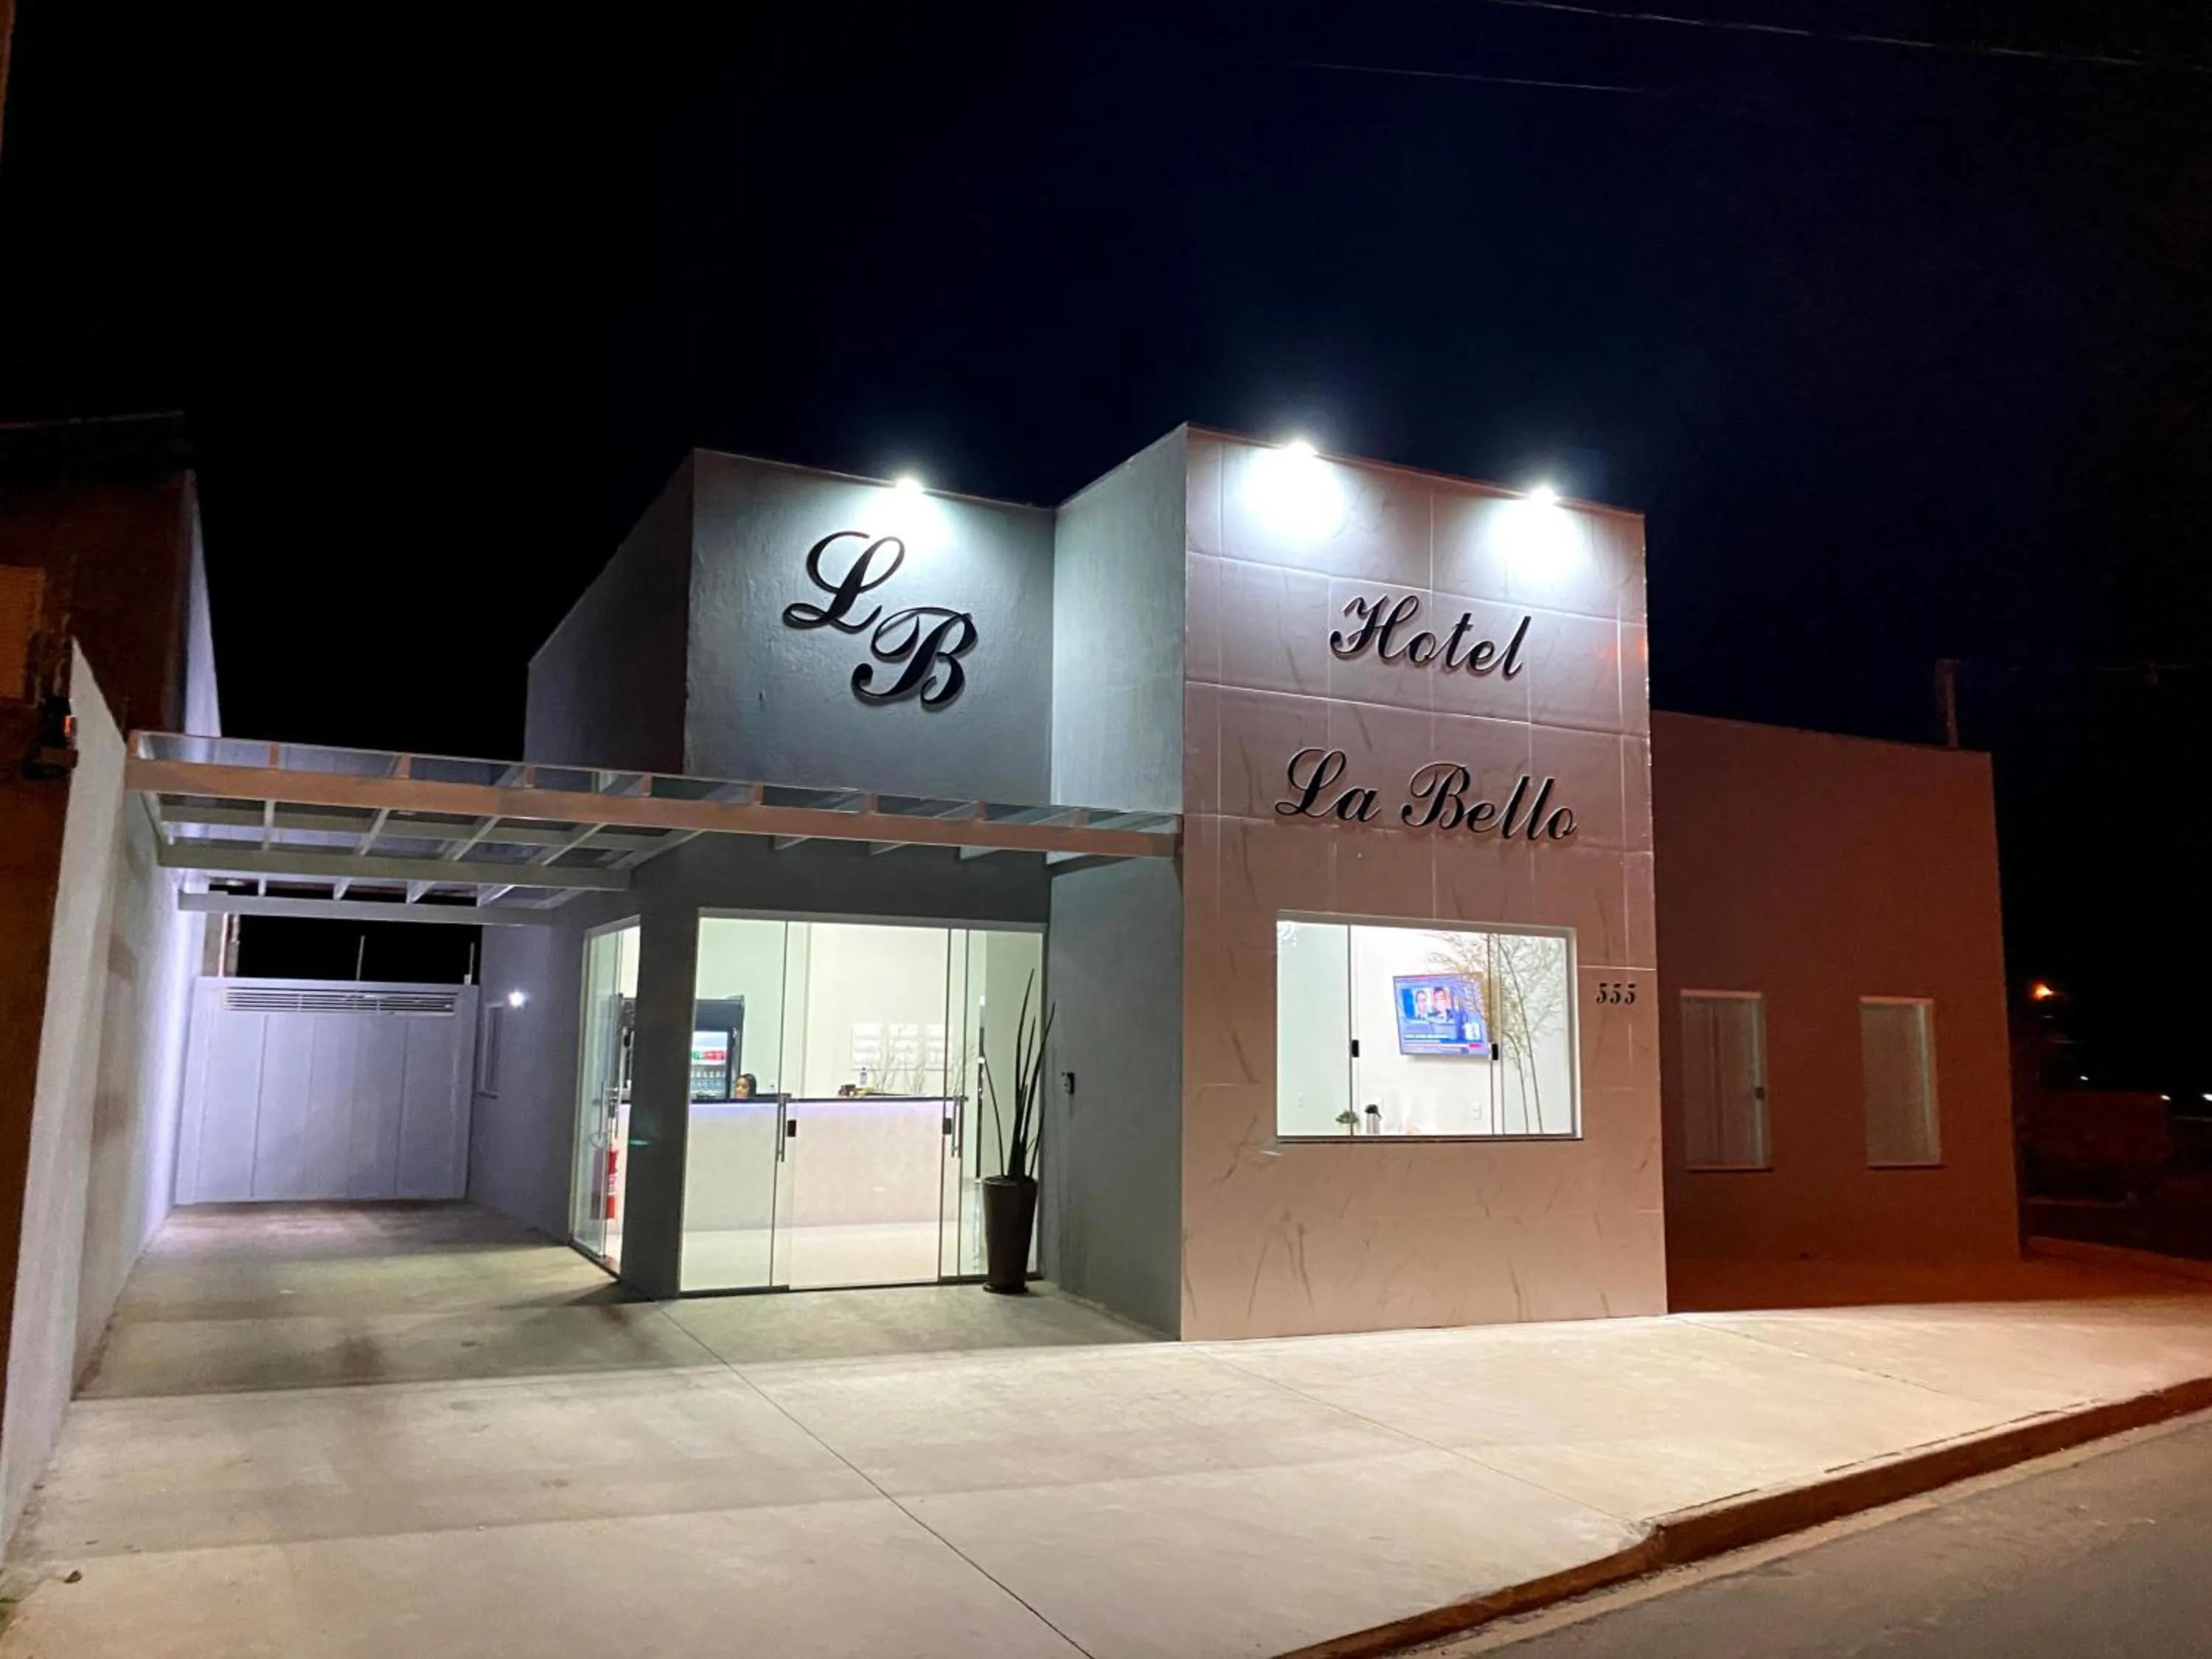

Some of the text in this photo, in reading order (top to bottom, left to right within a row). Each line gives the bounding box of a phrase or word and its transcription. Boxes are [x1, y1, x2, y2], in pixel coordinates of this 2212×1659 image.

[1329, 595, 1531, 679] Hotel
[1275, 748, 1577, 841] La Bello
[1596, 982, 1636, 1004] 555
